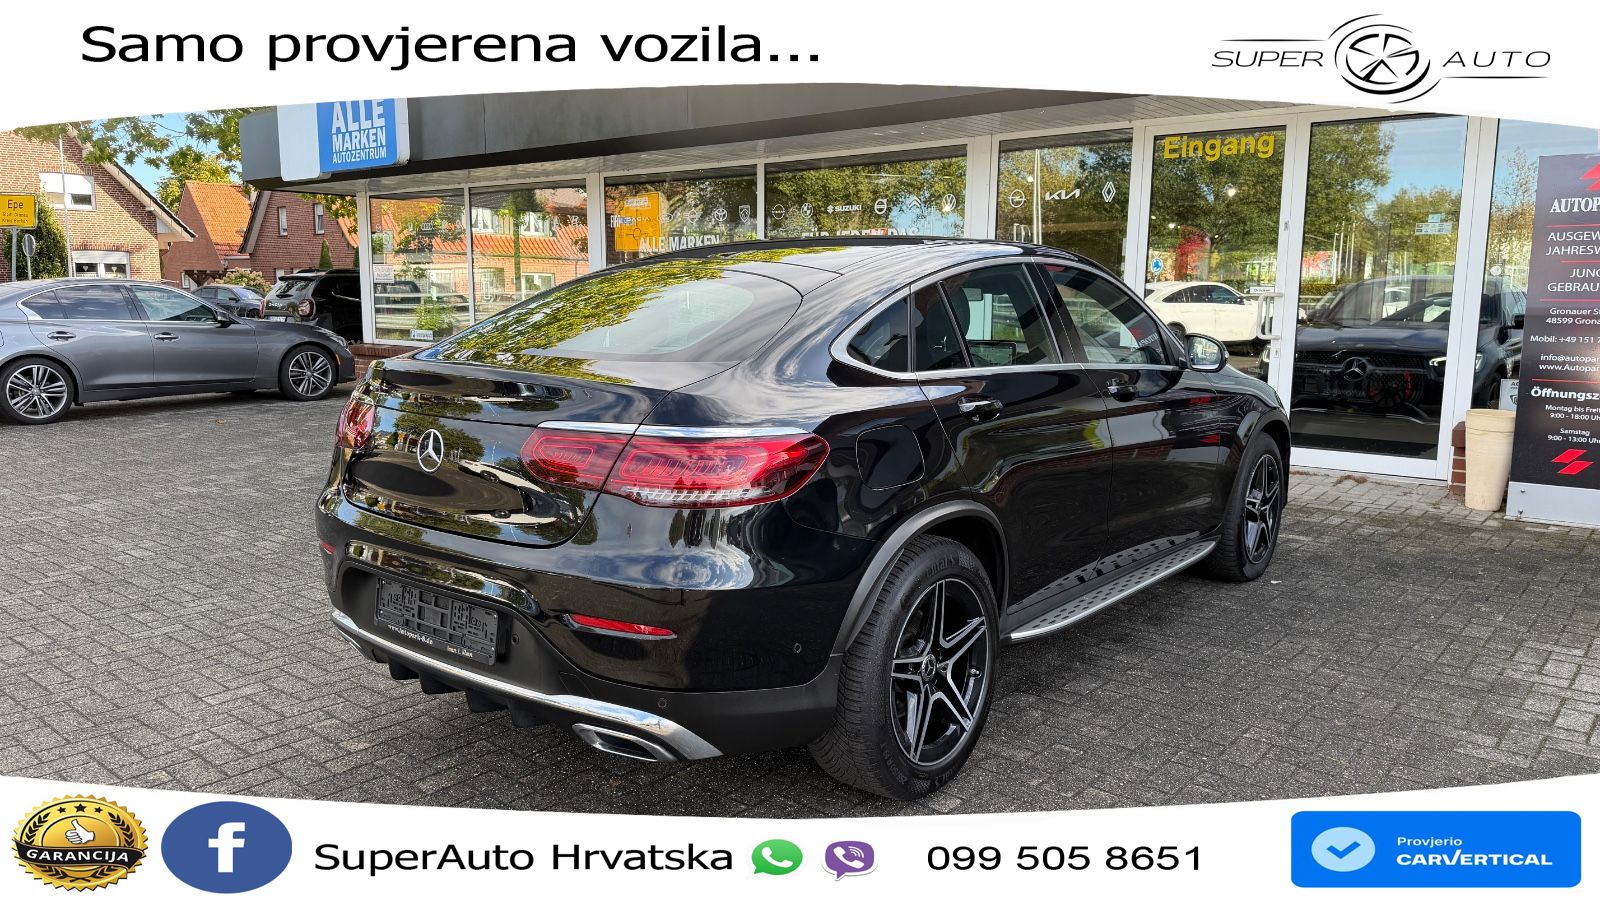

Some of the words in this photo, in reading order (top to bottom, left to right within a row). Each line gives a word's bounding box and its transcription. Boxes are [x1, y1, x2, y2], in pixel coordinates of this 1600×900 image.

[332, 99, 385, 133] ALLE
[332, 127, 386, 152] MARKEN
[1164, 134, 1275, 161] Eingang
[333, 147, 386, 164] AUTOZENTRUM
[7, 200, 24, 211] Epe
[835, 204, 862, 212] SUZUKI
[639, 237, 665, 258] ALLE
[1547, 283, 1599, 292] GEBRAU
[1550, 307, 1591, 315] Gronauer
[1530, 335, 1557, 343] Mobil:
[1545, 404, 1573, 413] Montag
[1571, 413, 1590, 421] 18:00
[1560, 428, 1591, 437] Samstag
[1569, 435, 1588, 443] 13:00
